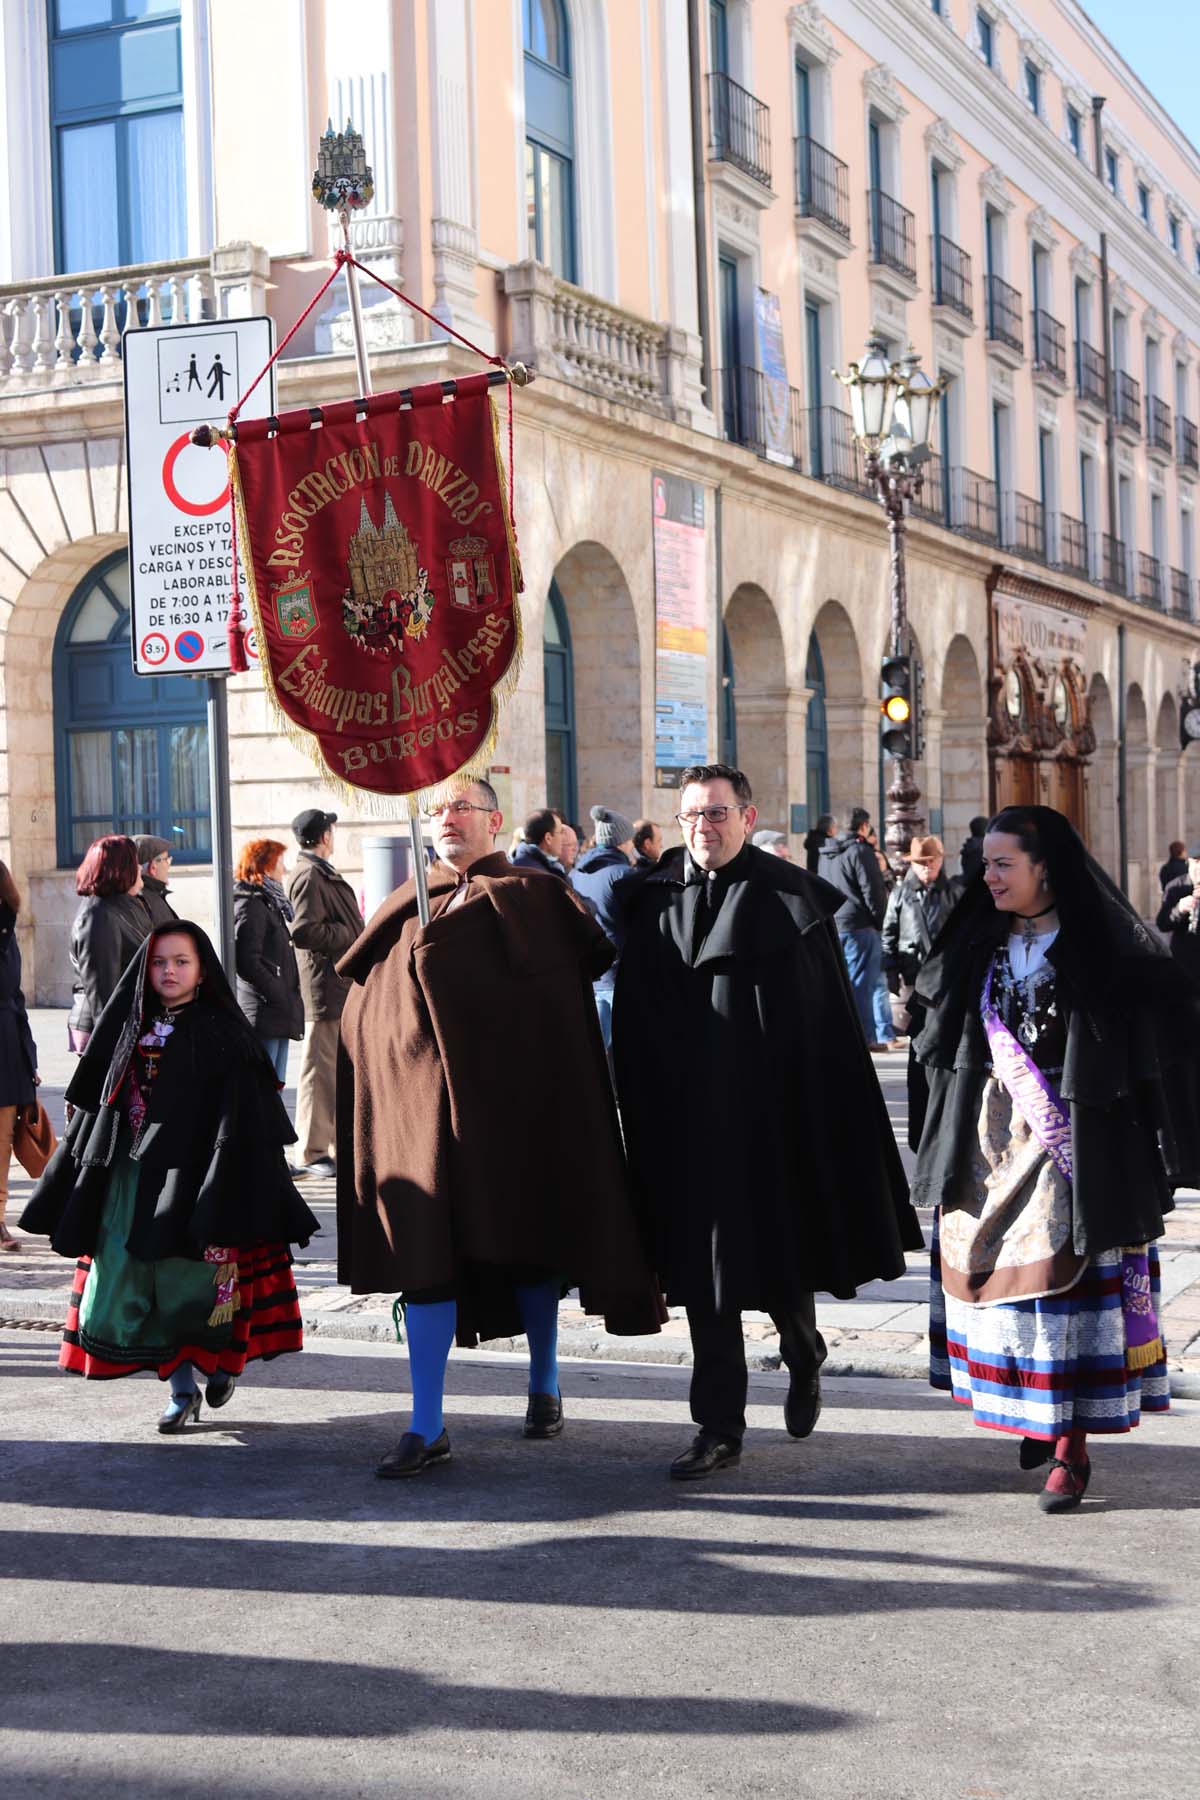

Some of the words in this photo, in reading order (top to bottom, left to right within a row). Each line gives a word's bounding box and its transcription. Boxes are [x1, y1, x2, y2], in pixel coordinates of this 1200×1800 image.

[266, 441, 382, 567] ASOCIACION
[384, 455, 400, 477] DE
[404, 440, 494, 526] DANZAS
[174, 521, 232, 537] EXCEPTO
[149, 541, 205, 556] VECINOS
[209, 540, 216, 551] Y
[139, 560, 183, 575] CARGA
[187, 559, 195, 570] Y
[150, 597, 166, 609] DE
[171, 595, 199, 607] 7:00
[203, 594, 212, 605] A
[149, 614, 166, 627] DE
[169, 612, 200, 625] 16:30
[204, 611, 213, 623] A
[278, 644, 388, 732] Estampas
[391, 612, 511, 724] Burgalesas
[338, 707, 480, 774] BURGOS
